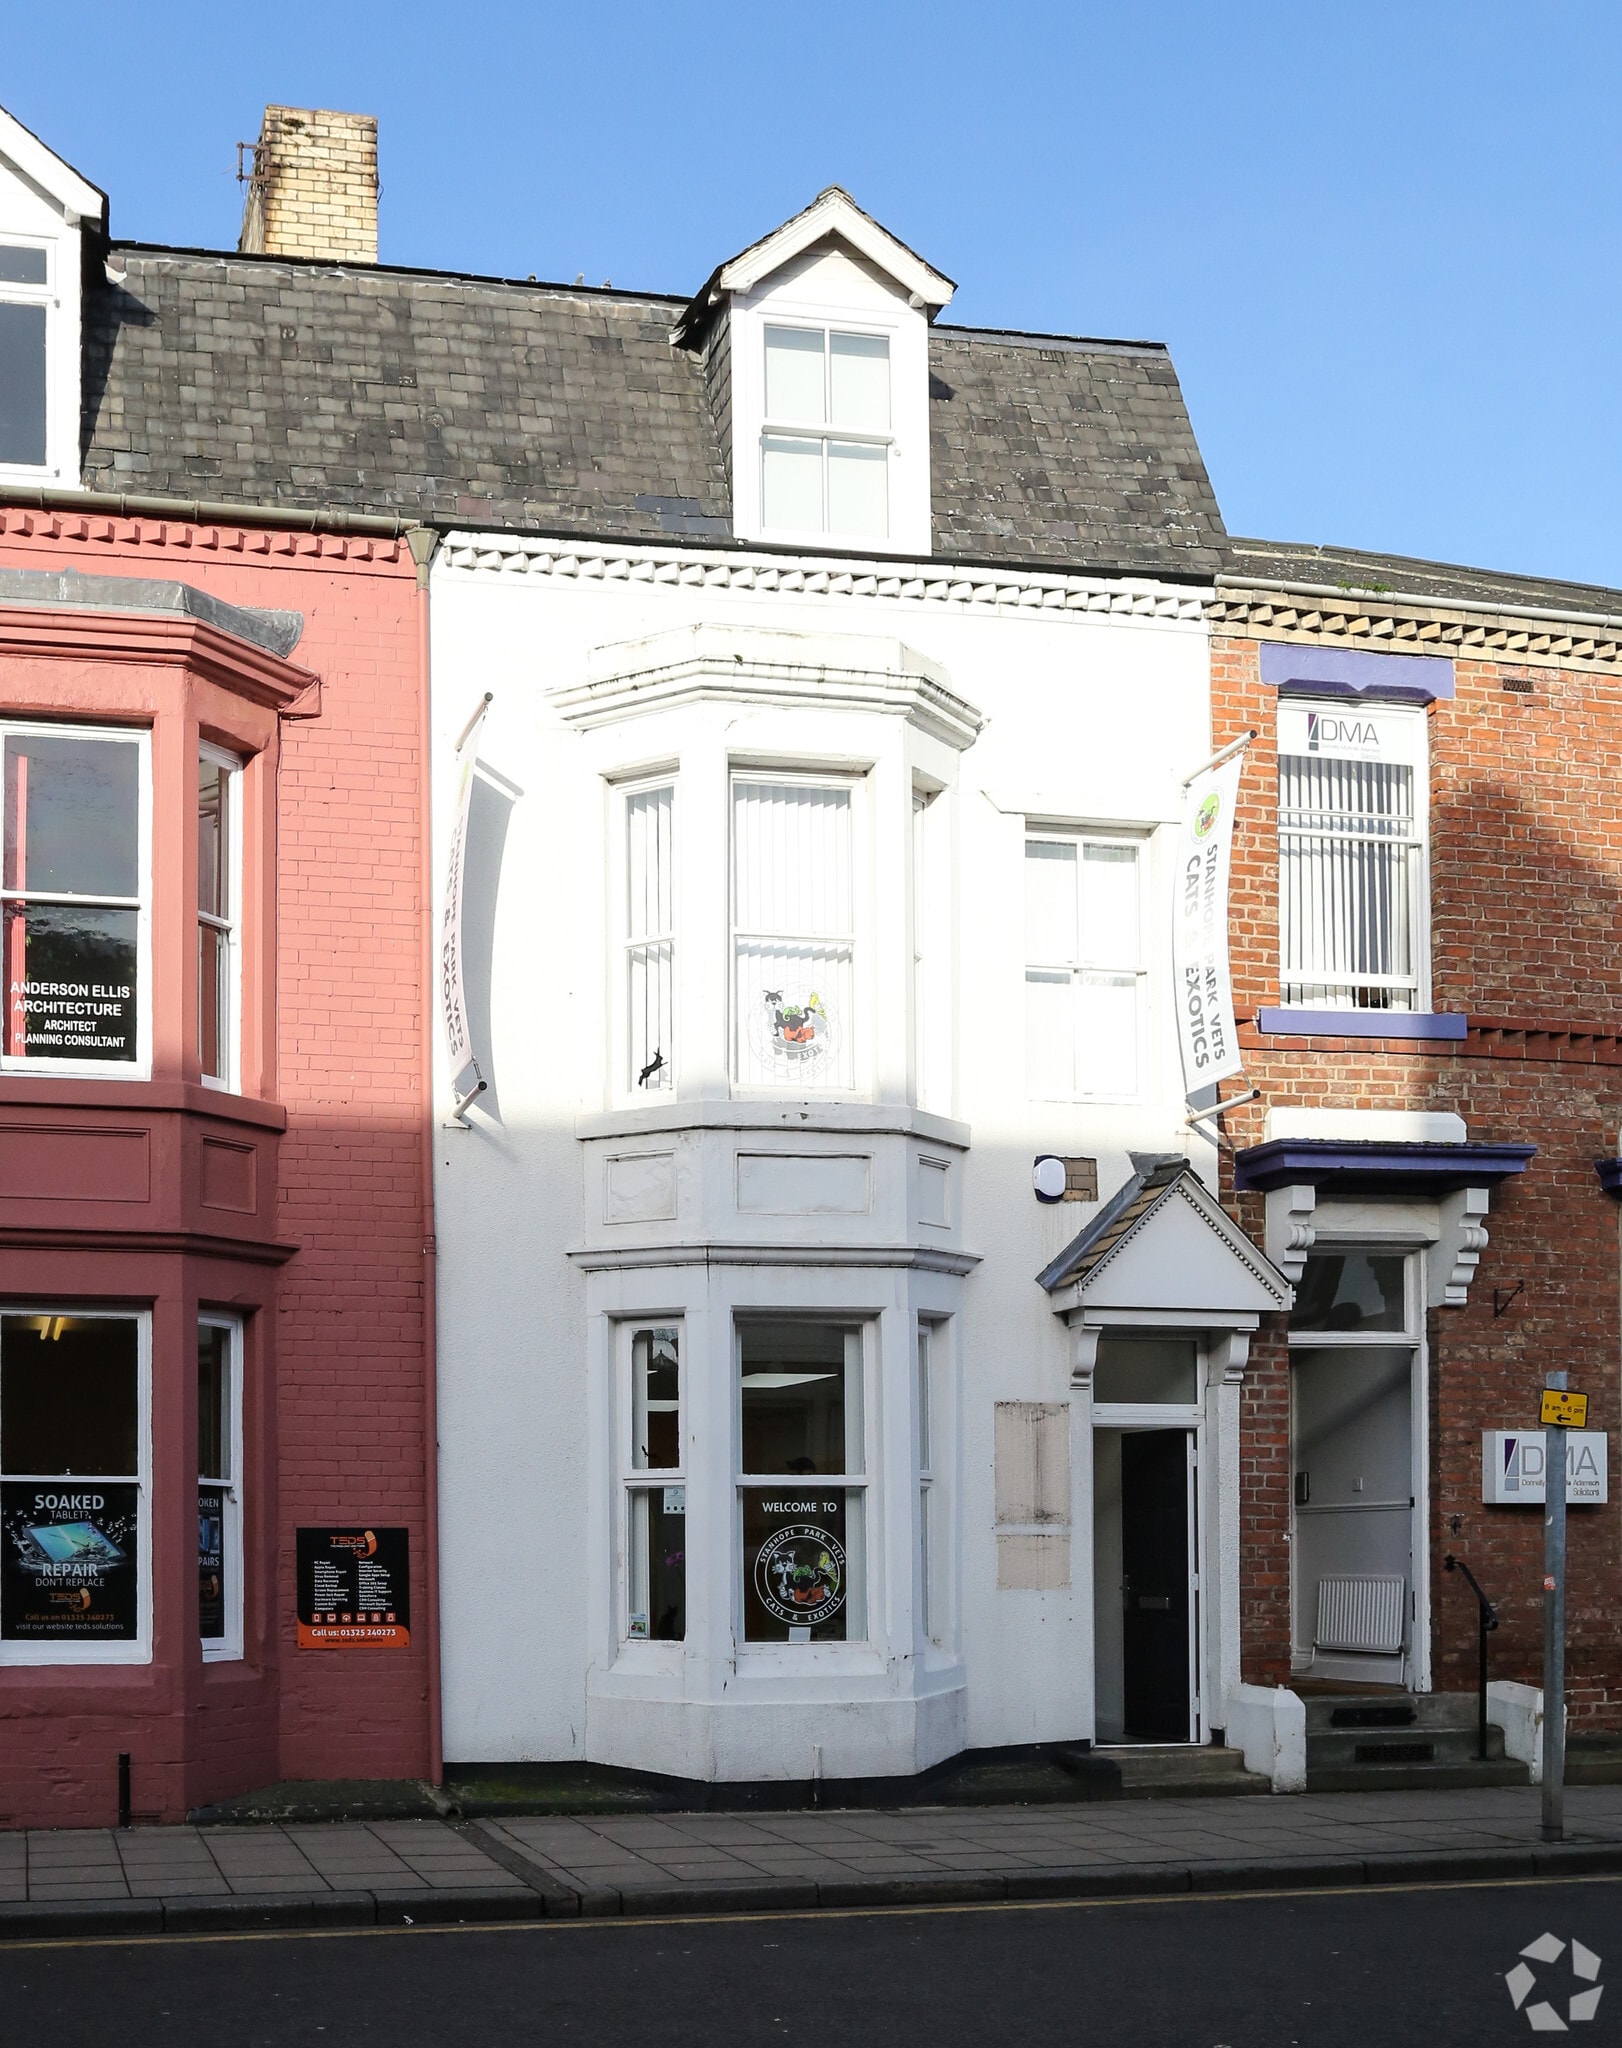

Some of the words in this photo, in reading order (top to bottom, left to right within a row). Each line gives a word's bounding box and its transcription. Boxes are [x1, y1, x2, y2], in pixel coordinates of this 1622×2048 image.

[1321, 719, 1379, 745] DMA
[1184, 855, 1201, 917] CATS
[1204, 952, 1218, 1007] PARK
[10, 981, 89, 997] ANDERSON
[92, 985, 131, 998] ELLIS
[443, 941, 458, 1056] EXOTICS
[14, 1000, 122, 1016] ARCHITECTURE
[1186, 961, 1209, 1069] EXOTICS
[44, 1020, 97, 1032] ARCHITECT
[454, 997, 464, 1048] VETS
[15, 1033, 62, 1045] PLANNING
[65, 1034, 125, 1047] CONSULTANT
[1210, 1013, 1226, 1061] VETS
[1574, 1407, 1584, 1415] pm
[34, 1494, 105, 1510] SOAKED
[199, 1498, 219, 1507] OKEN
[762, 1502, 817, 1513] WELCOME
[822, 1502, 837, 1513] TO
[51, 1510, 90, 1519] TABLET?
[330, 1536, 366, 1544] TEDS
[760, 1529, 795, 1563] STANHOPE
[804, 1528, 827, 1541] PARK
[831, 1543, 846, 1565] VETS
[198, 1557, 219, 1566] PAIRS
[42, 1564, 99, 1577] REPAIR
[35, 1578, 63, 1587] DON'T
[66, 1578, 105, 1587] REPLACE
[766, 1597, 785, 1616] CATS
[807, 1596, 841, 1621] EXOTICS
[25, 1613, 39, 1621] Call
[311, 1628, 326, 1636] Call
[340, 1628, 365, 1636] 01325
[367, 1628, 396, 1637] 240273
